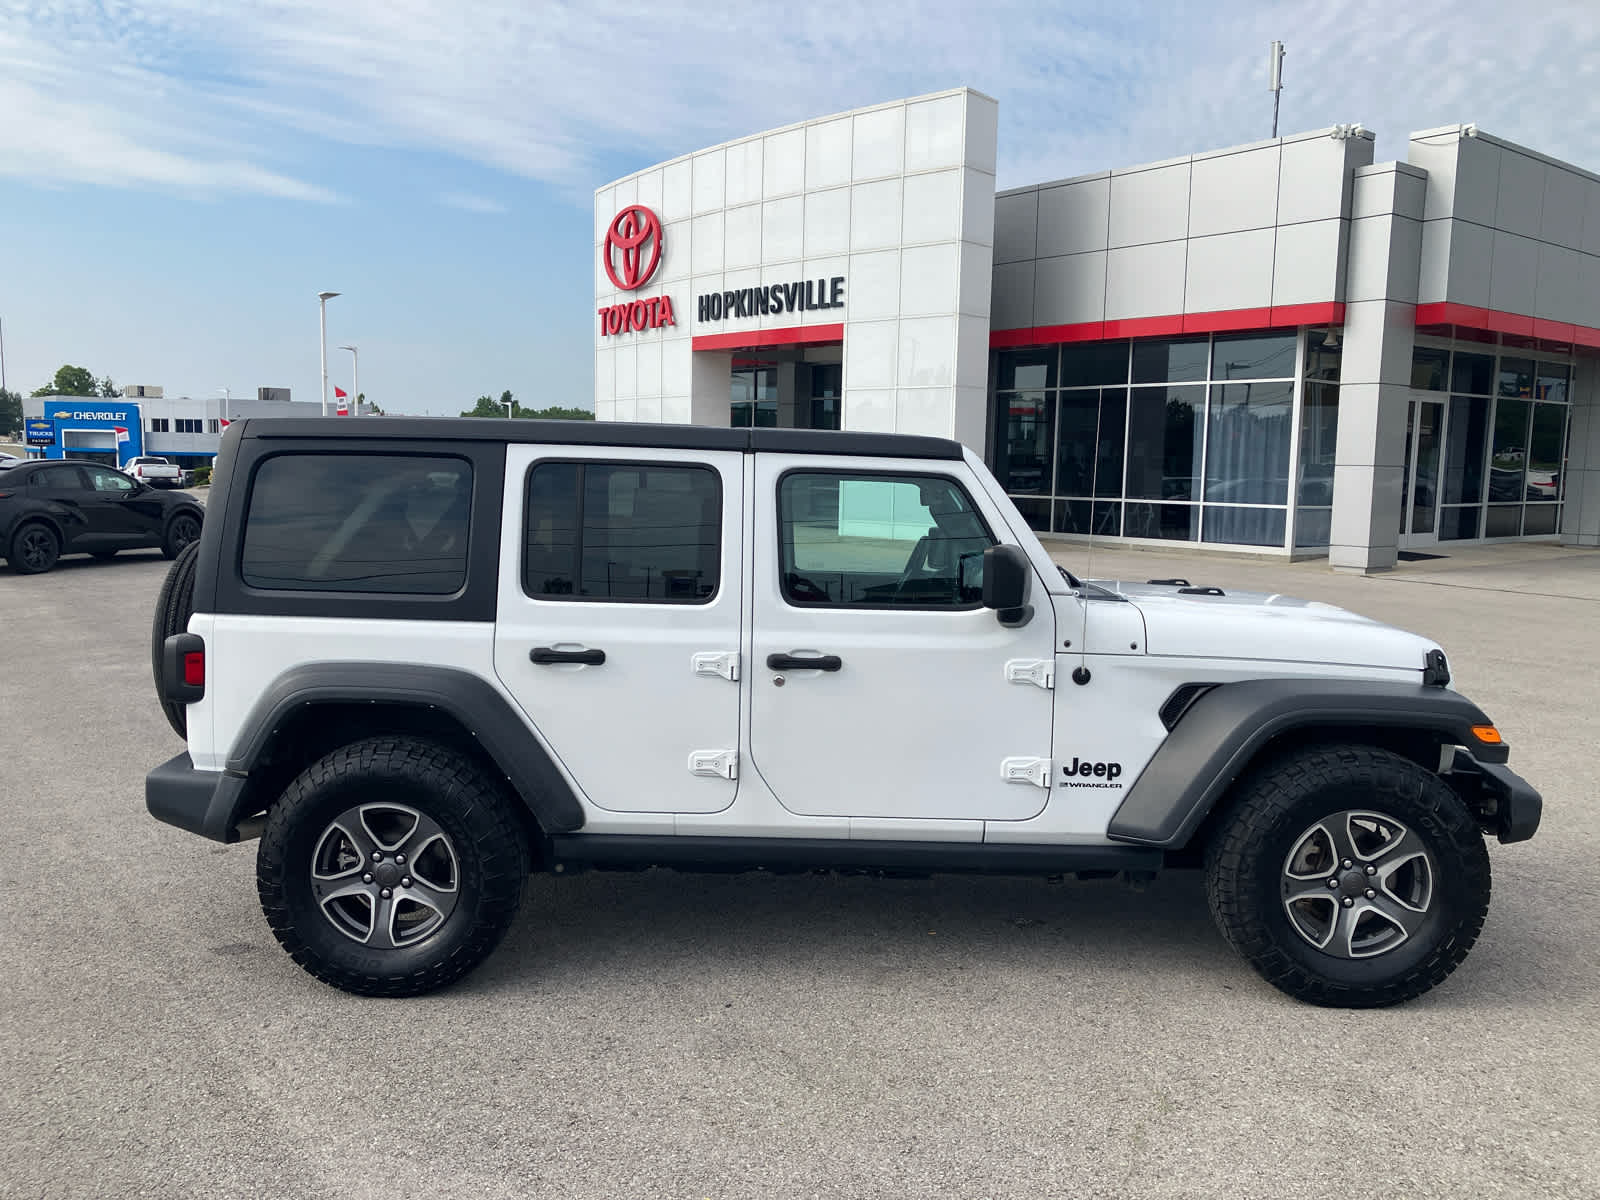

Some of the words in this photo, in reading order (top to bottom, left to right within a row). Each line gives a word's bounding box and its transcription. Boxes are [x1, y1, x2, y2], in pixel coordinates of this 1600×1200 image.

[698, 276, 844, 322] HOPKINSVILLE
[598, 295, 675, 336] TOYOTA
[73, 411, 127, 420] CHEVROLET
[1063, 757, 1121, 781] Jeep
